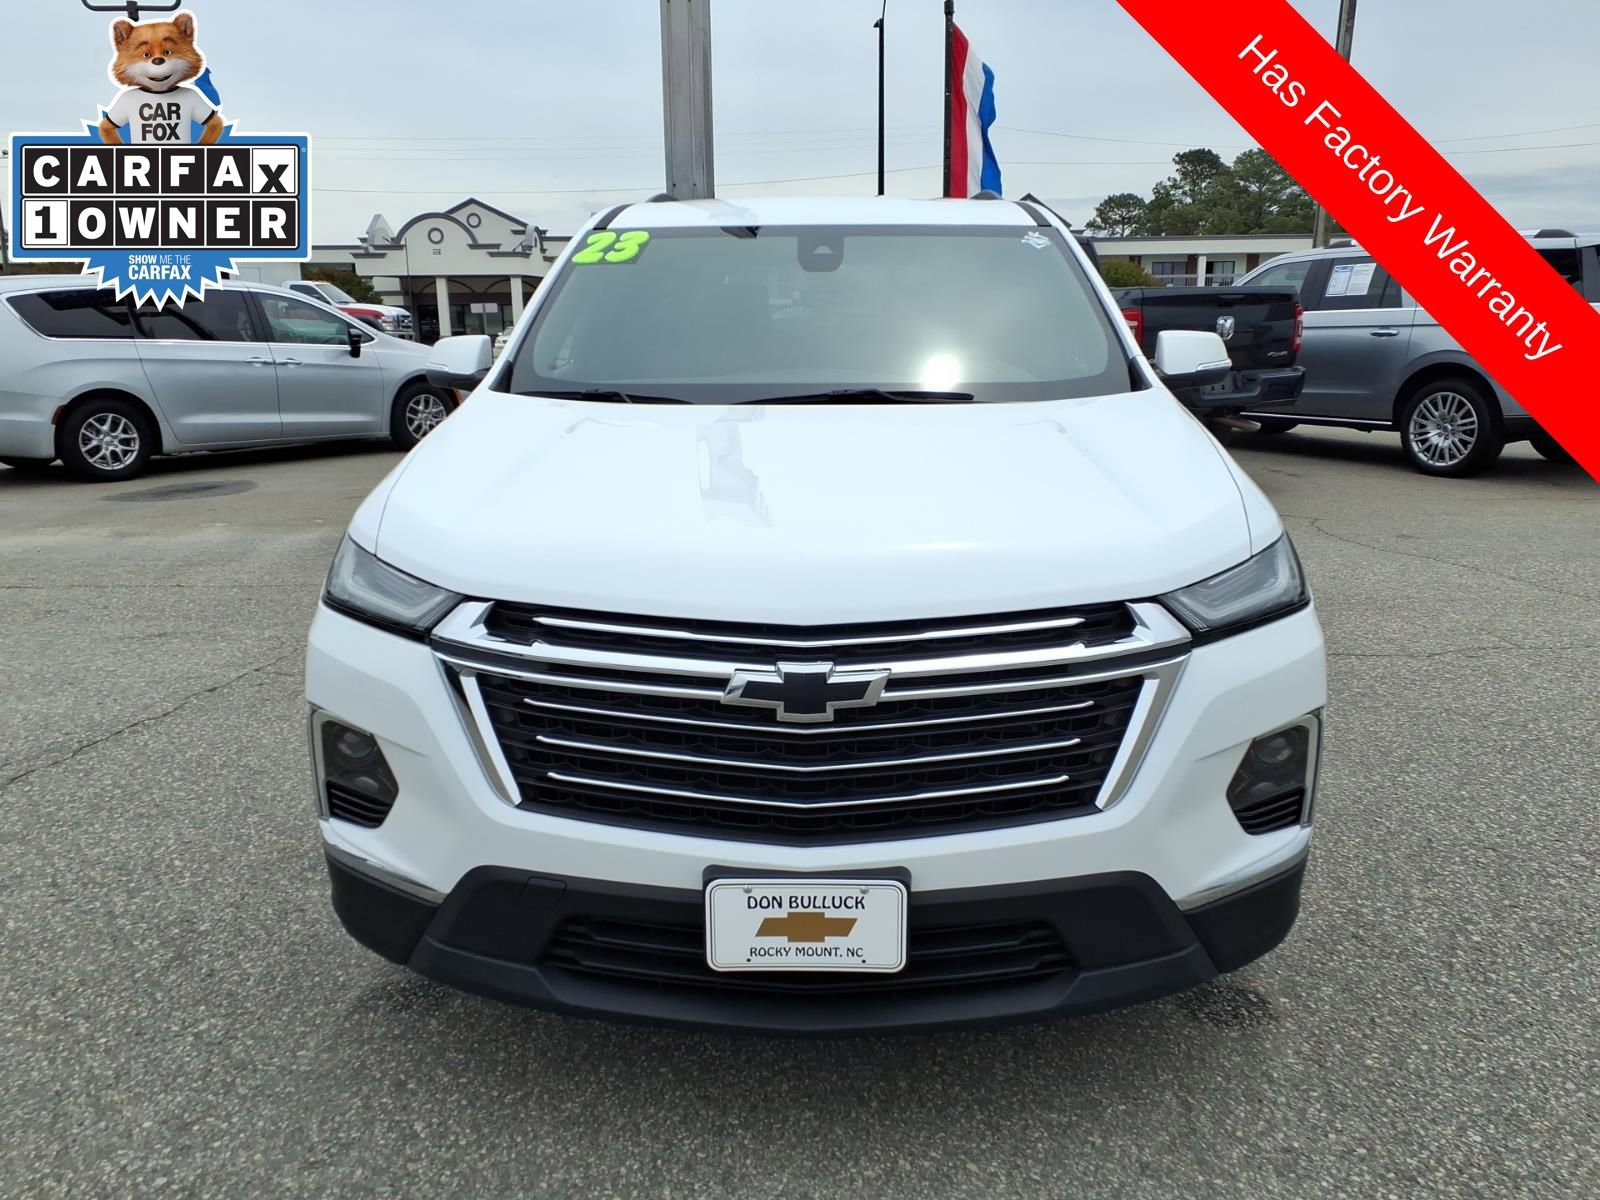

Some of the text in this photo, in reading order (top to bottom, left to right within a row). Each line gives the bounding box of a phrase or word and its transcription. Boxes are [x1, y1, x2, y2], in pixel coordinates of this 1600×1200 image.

[571, 230, 650, 264] 23
[746, 895, 866, 910] DON BULLUCK
[749, 946, 792, 957] ROCKY
[846, 946, 864, 958] NC
